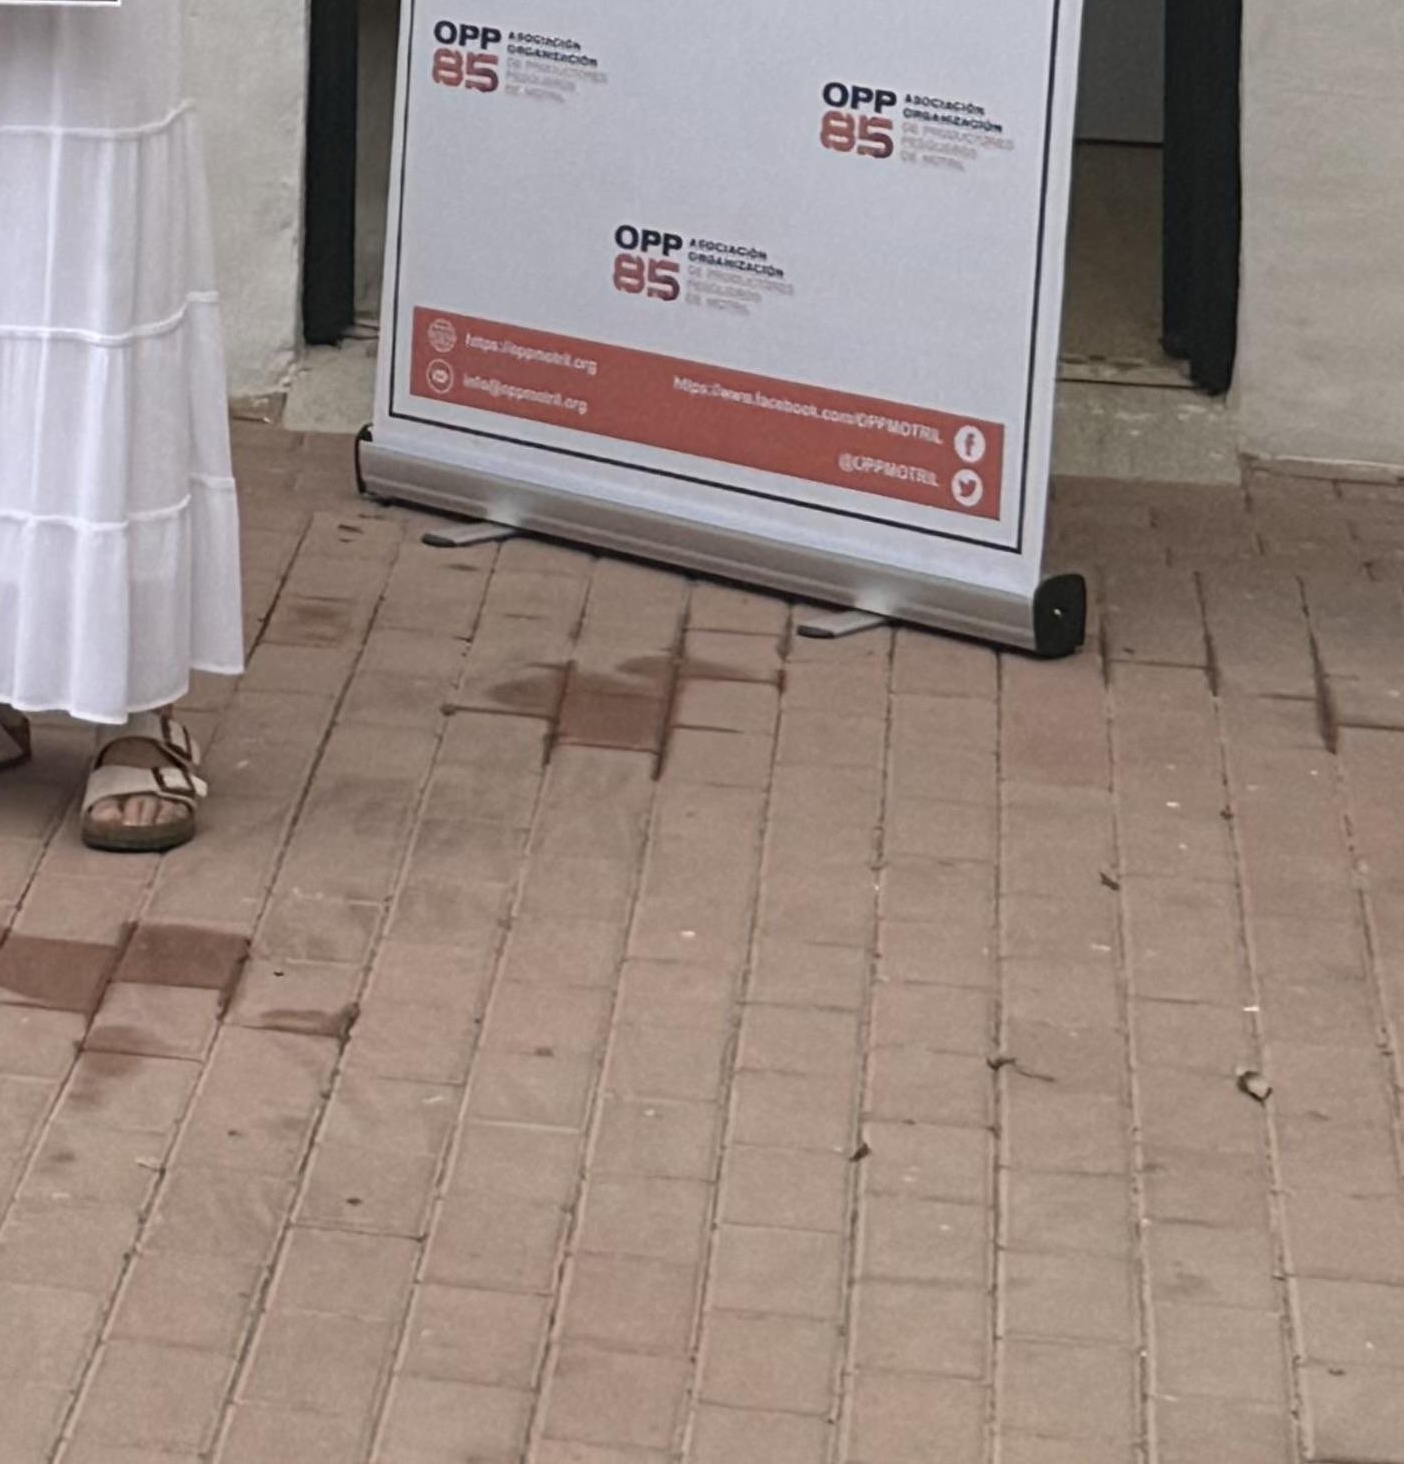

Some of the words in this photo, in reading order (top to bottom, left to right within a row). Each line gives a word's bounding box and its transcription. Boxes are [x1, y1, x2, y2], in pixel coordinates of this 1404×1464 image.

[434, 21, 502, 49] OPP
[433, 48, 499, 92] 85
[823, 82, 897, 113] OPP
[821, 110, 893, 158] 85
[615, 225, 682, 256] OPP
[614, 253, 680, 301] 85
